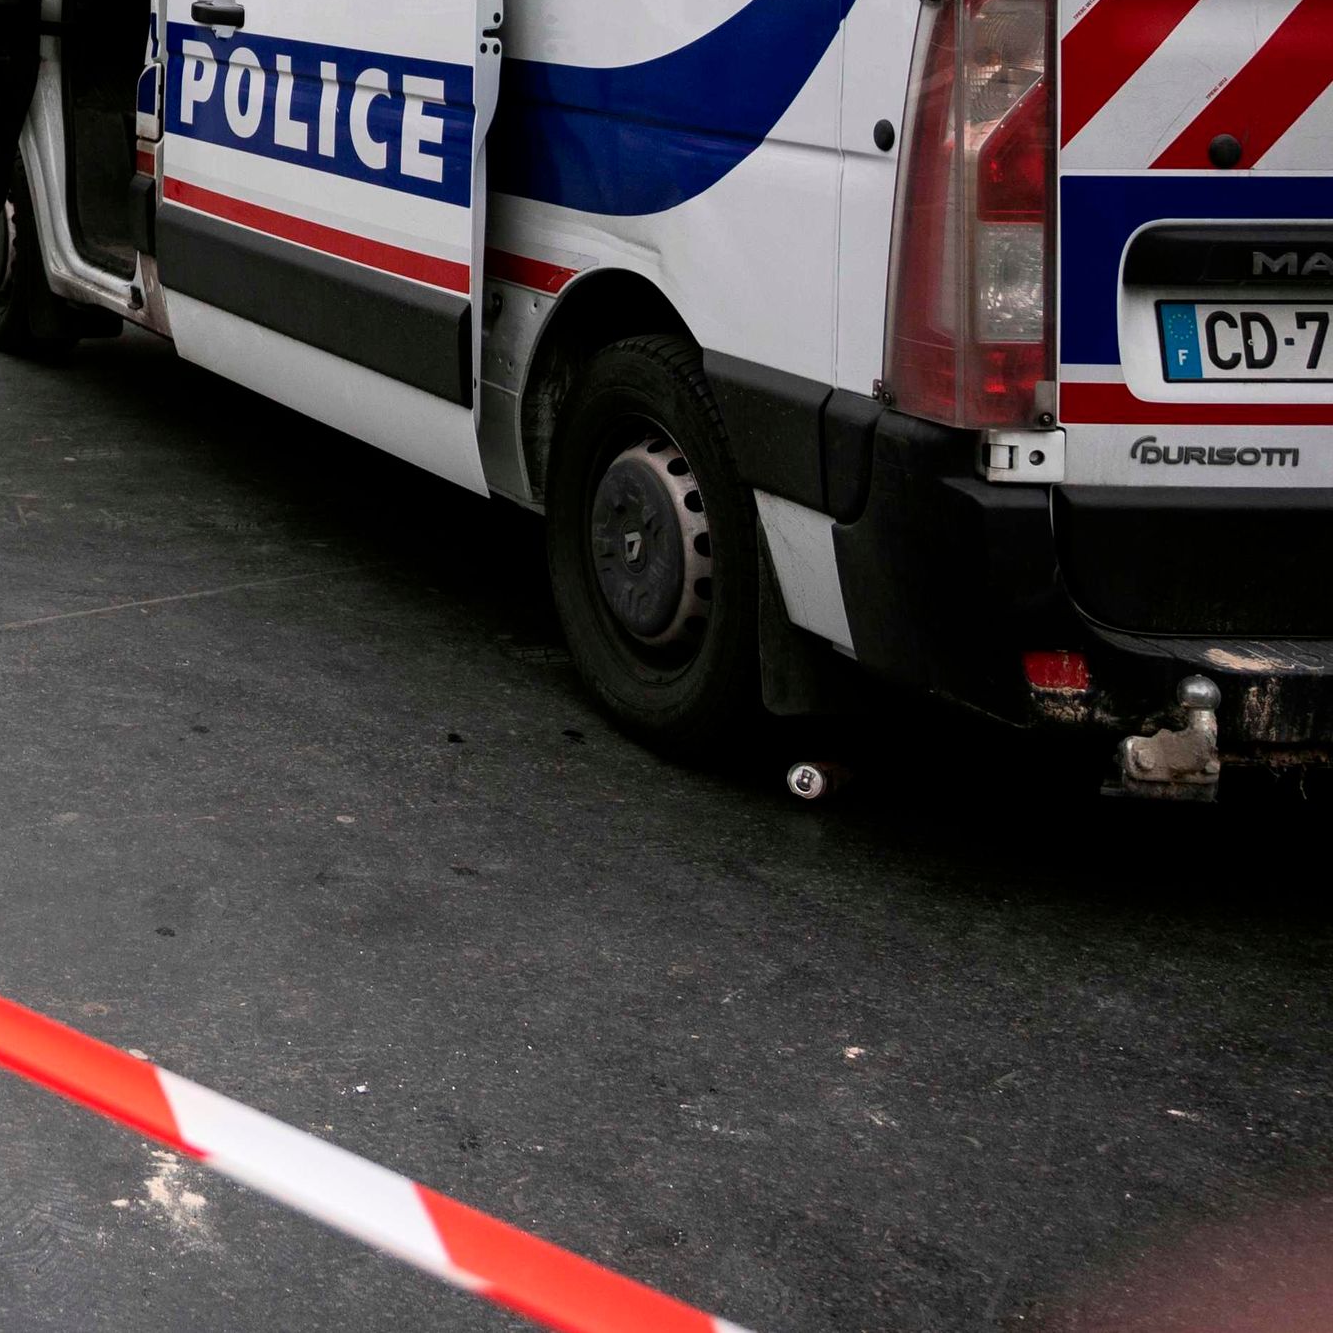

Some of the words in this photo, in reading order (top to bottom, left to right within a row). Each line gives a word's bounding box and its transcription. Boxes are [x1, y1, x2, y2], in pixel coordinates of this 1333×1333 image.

[180, 39, 446, 183] POLICE
[1178, 349, 1189, 366] F
[1205, 310, 1330, 370] CD-7
[1137, 444, 1300, 468] DURISOTTI
